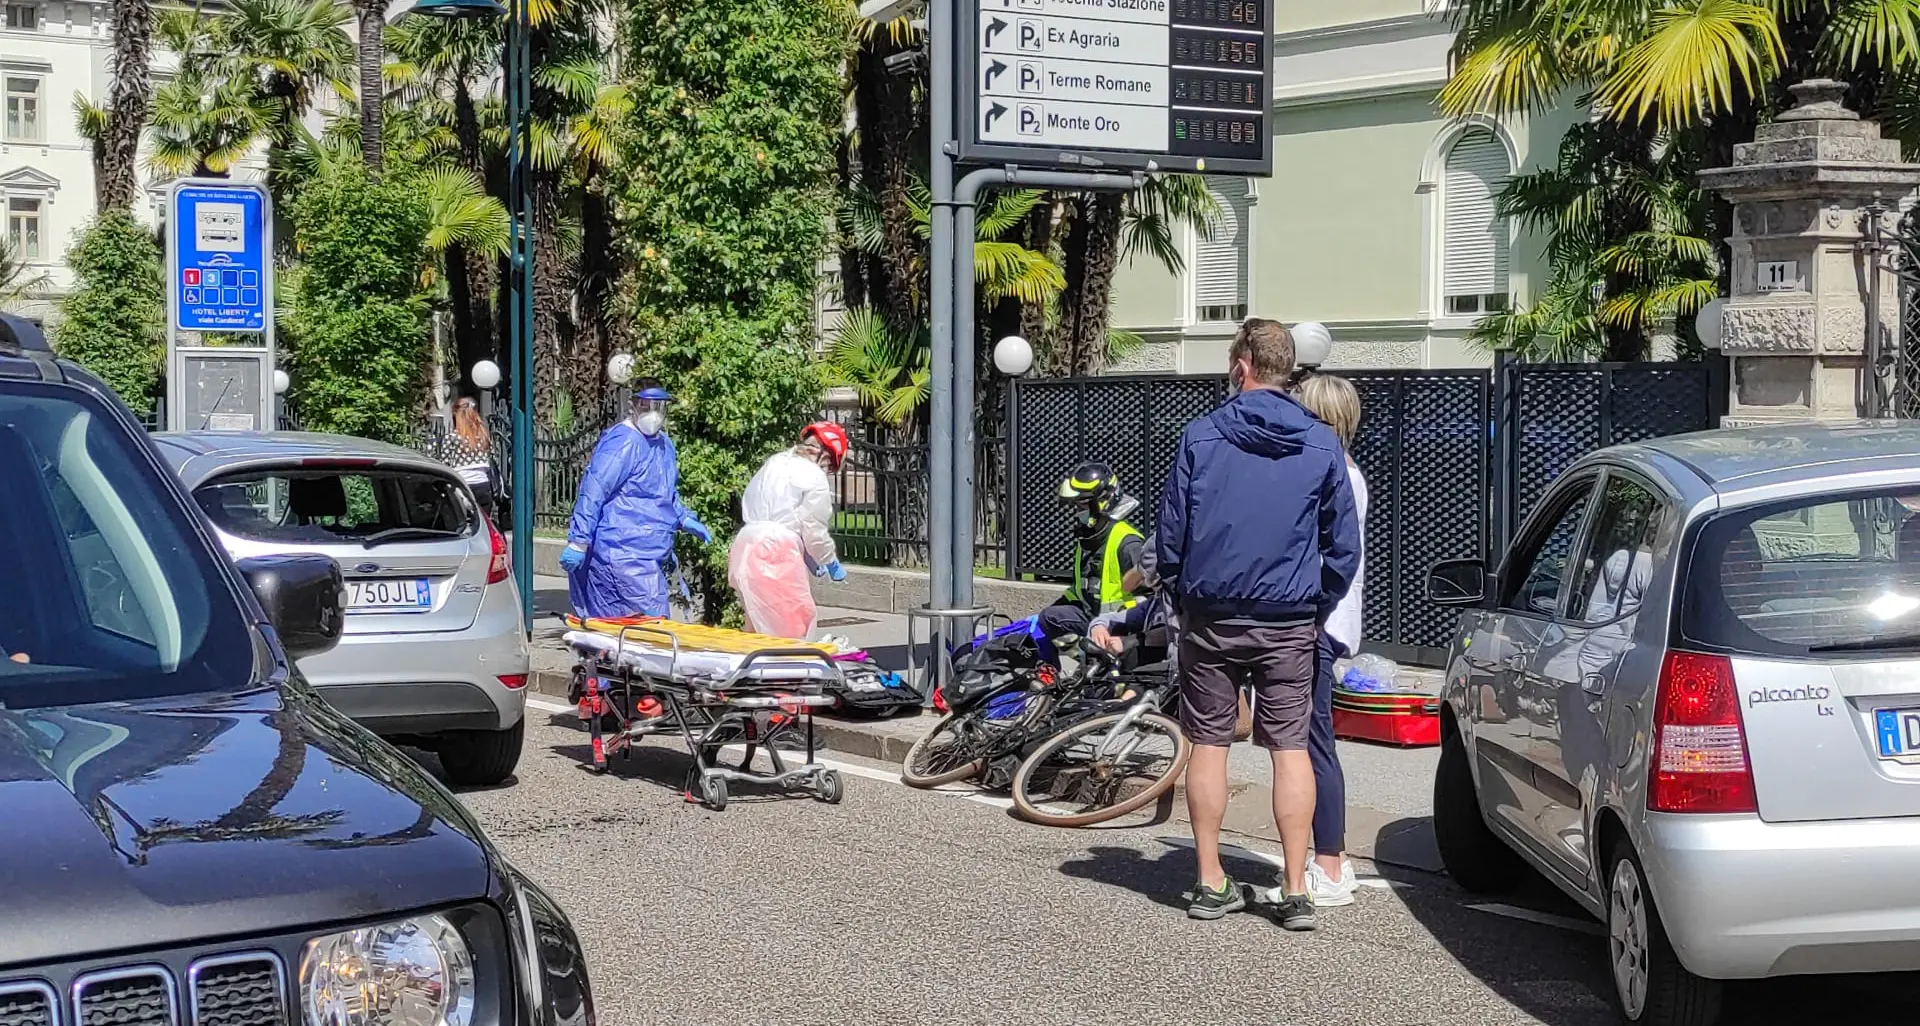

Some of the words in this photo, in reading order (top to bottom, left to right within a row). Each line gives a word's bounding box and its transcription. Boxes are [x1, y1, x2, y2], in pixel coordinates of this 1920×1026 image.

[1047, 28, 1065, 43] Ex
[1069, 29, 1120, 49] Agraria
[1047, 71, 1091, 90] Terme
[1095, 75, 1152, 93] Romane
[1047, 115, 1090, 131] Monte
[1094, 116, 1120, 132] Oro
[207, 274, 216, 283] 3
[1769, 264, 1785, 283] 11
[191, 308, 217, 316] HOTEL
[218, 308, 250, 316] LIBERTY
